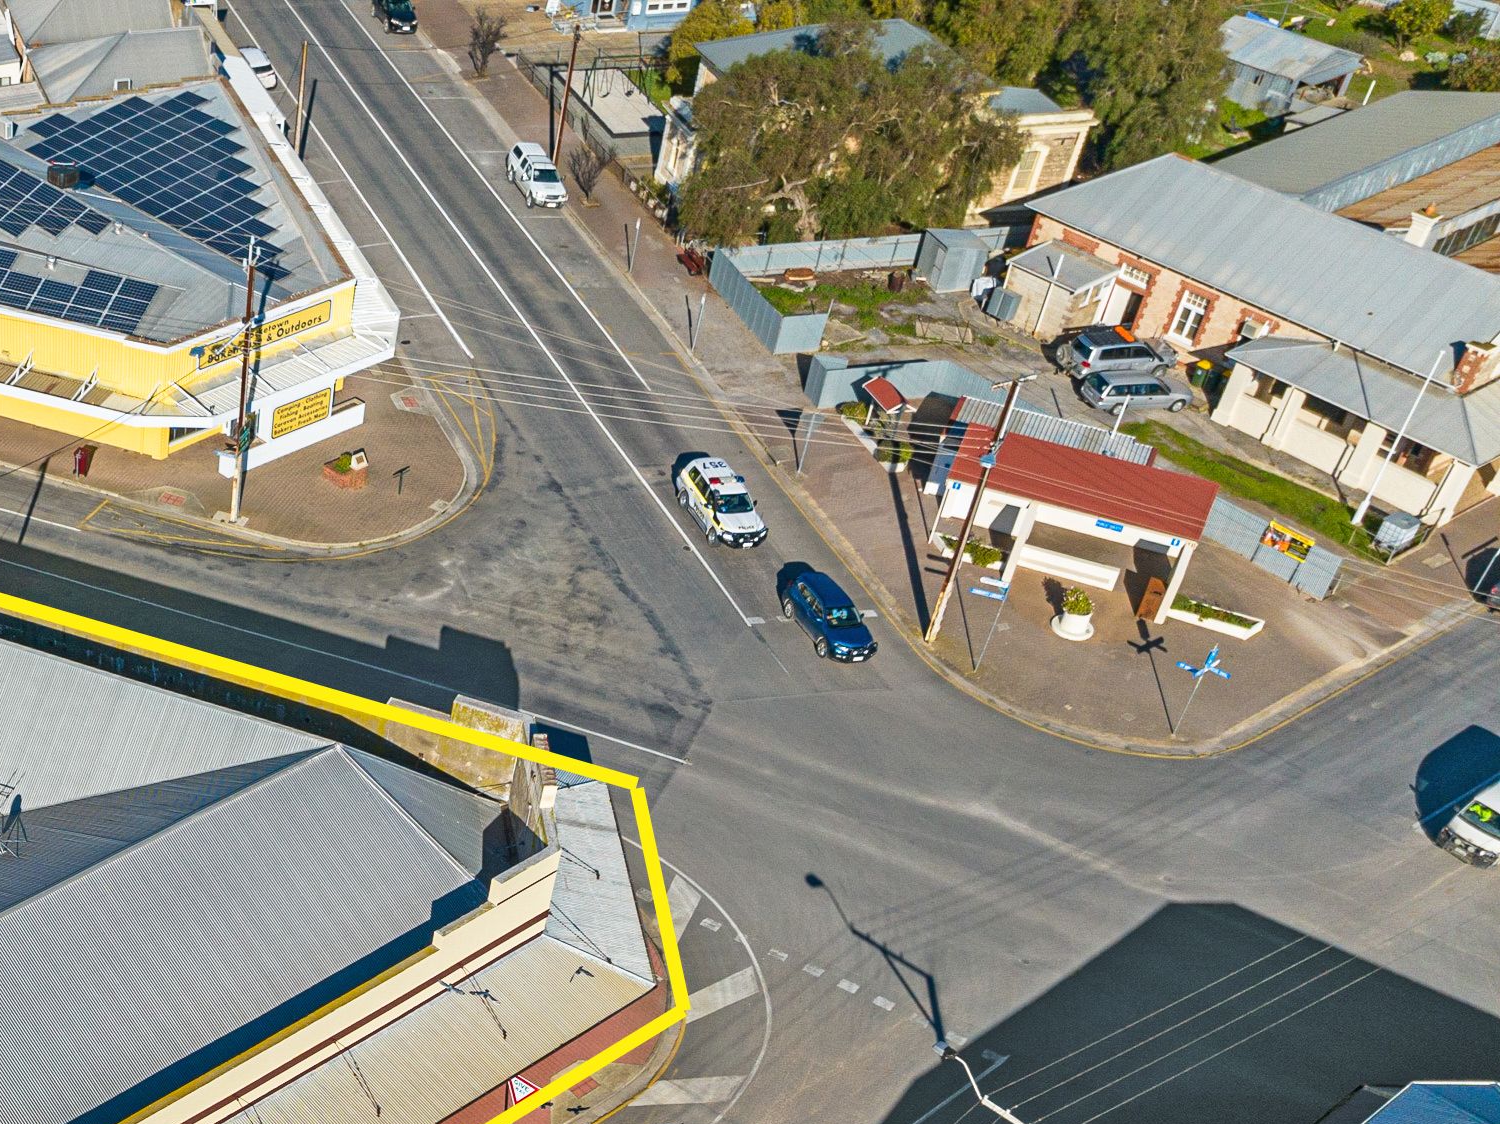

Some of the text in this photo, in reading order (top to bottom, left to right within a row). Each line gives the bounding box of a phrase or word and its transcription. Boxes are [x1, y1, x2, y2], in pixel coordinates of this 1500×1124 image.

[276, 315, 322, 338] Outdoors
[277, 392, 327, 414] Camping Clothing
[274, 417, 296, 428] Caravan
[280, 410, 298, 419] Fishing
[274, 425, 292, 435] Bakery
[298, 417, 312, 426] Fresh
[513, 1079, 530, 1093] GIVE
